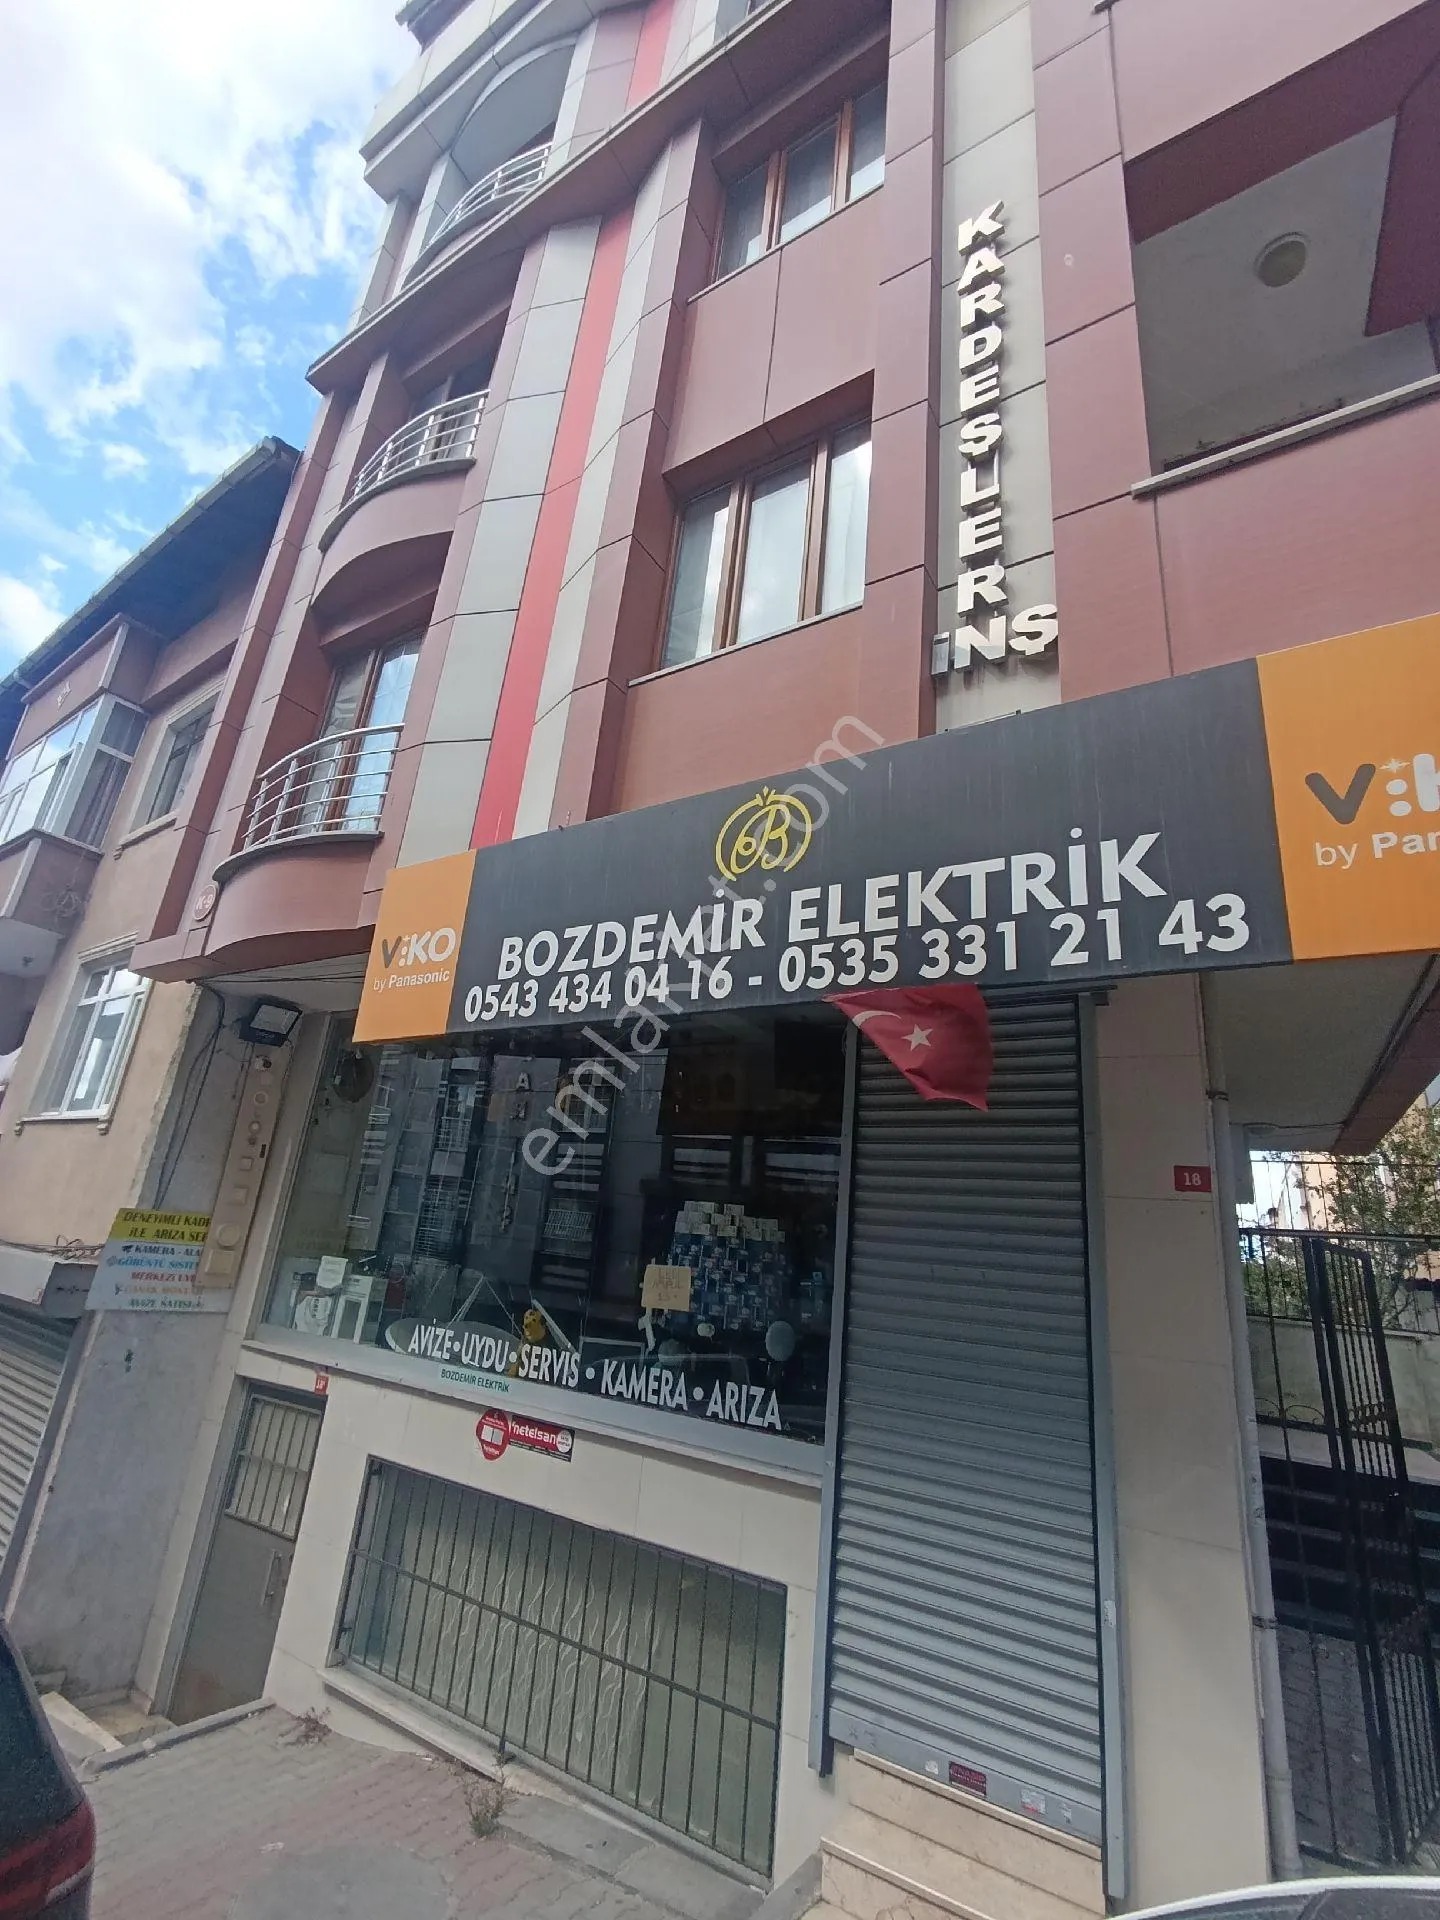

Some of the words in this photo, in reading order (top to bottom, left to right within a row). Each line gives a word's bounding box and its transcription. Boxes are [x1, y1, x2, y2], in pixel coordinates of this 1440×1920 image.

[957, 200, 1008, 618] KARDEŞLER
[1315, 842, 1358, 870] by
[497, 887, 766, 981] BOZDEMİR
[787, 827, 1168, 943] ELEKTRİK
[463, 977, 540, 1023] 0543
[548, 970, 612, 1014] 434
[624, 963, 670, 1008] 04
[687, 955, 734, 1000] 16
[778, 934, 899, 993] 0535
[918, 920, 1018, 980] 331
[1048, 908, 1122, 968] 21
[1158, 892, 1250, 956] 43
[373, 977, 386, 993] by
[388, 967, 451, 990] Panasonic
[1183, 1172, 1202, 1186] 18
[128, 1227, 146, 1238] İLE
[153, 1229, 185, 1241] ARIZA
[134, 1244, 176, 1256] KAMERA
[407, 1318, 455, 1360] AVİZE
[460, 1331, 511, 1373] UYDU
[601, 1359, 689, 1411] KAMERA
[706, 1379, 783, 1432] ARIZA
[440, 1368, 476, 1386] BOZDEMİR
[477, 1377, 510, 1393] ELEKTRİK
